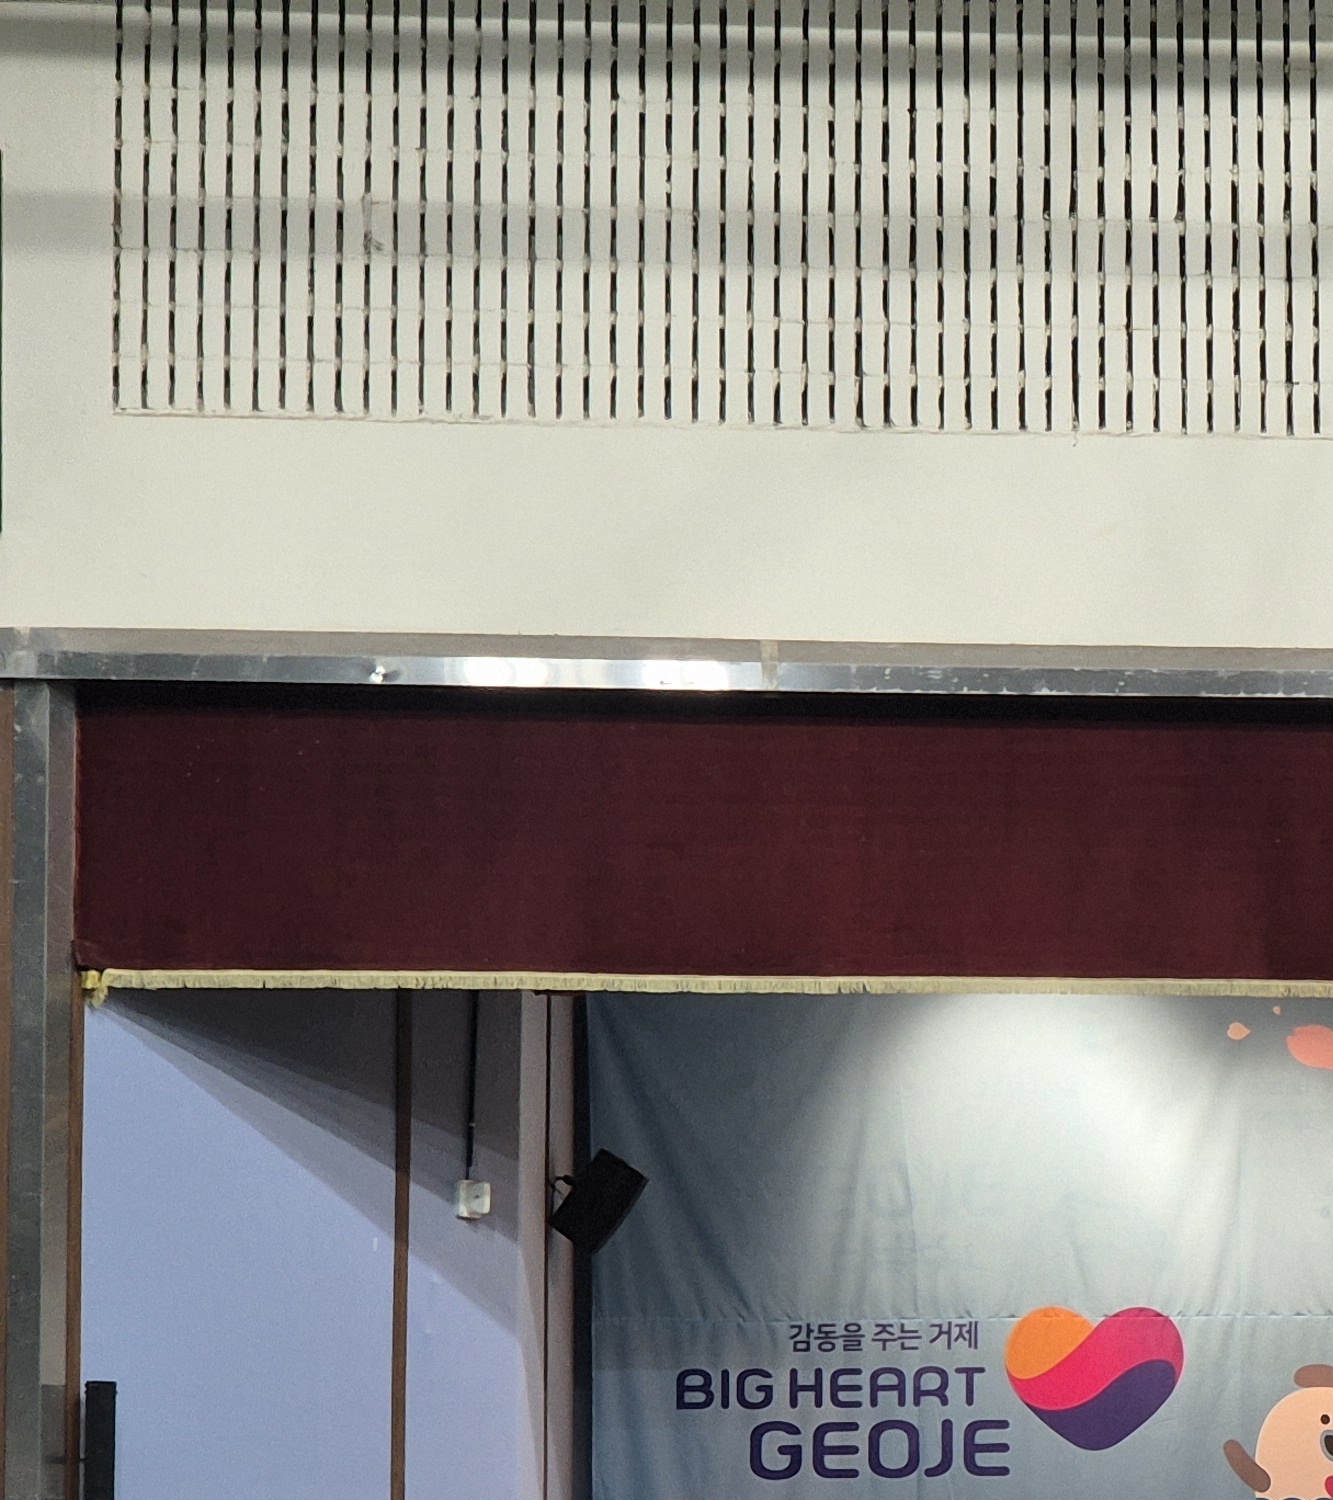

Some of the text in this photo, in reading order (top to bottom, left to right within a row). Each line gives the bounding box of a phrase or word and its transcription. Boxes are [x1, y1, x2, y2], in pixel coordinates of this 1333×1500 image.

[789, 1320, 978, 1352] 감동을 주는 거제
[676, 1366, 986, 1410] BIG HEART
[749, 1419, 1010, 1480] GEOJE
